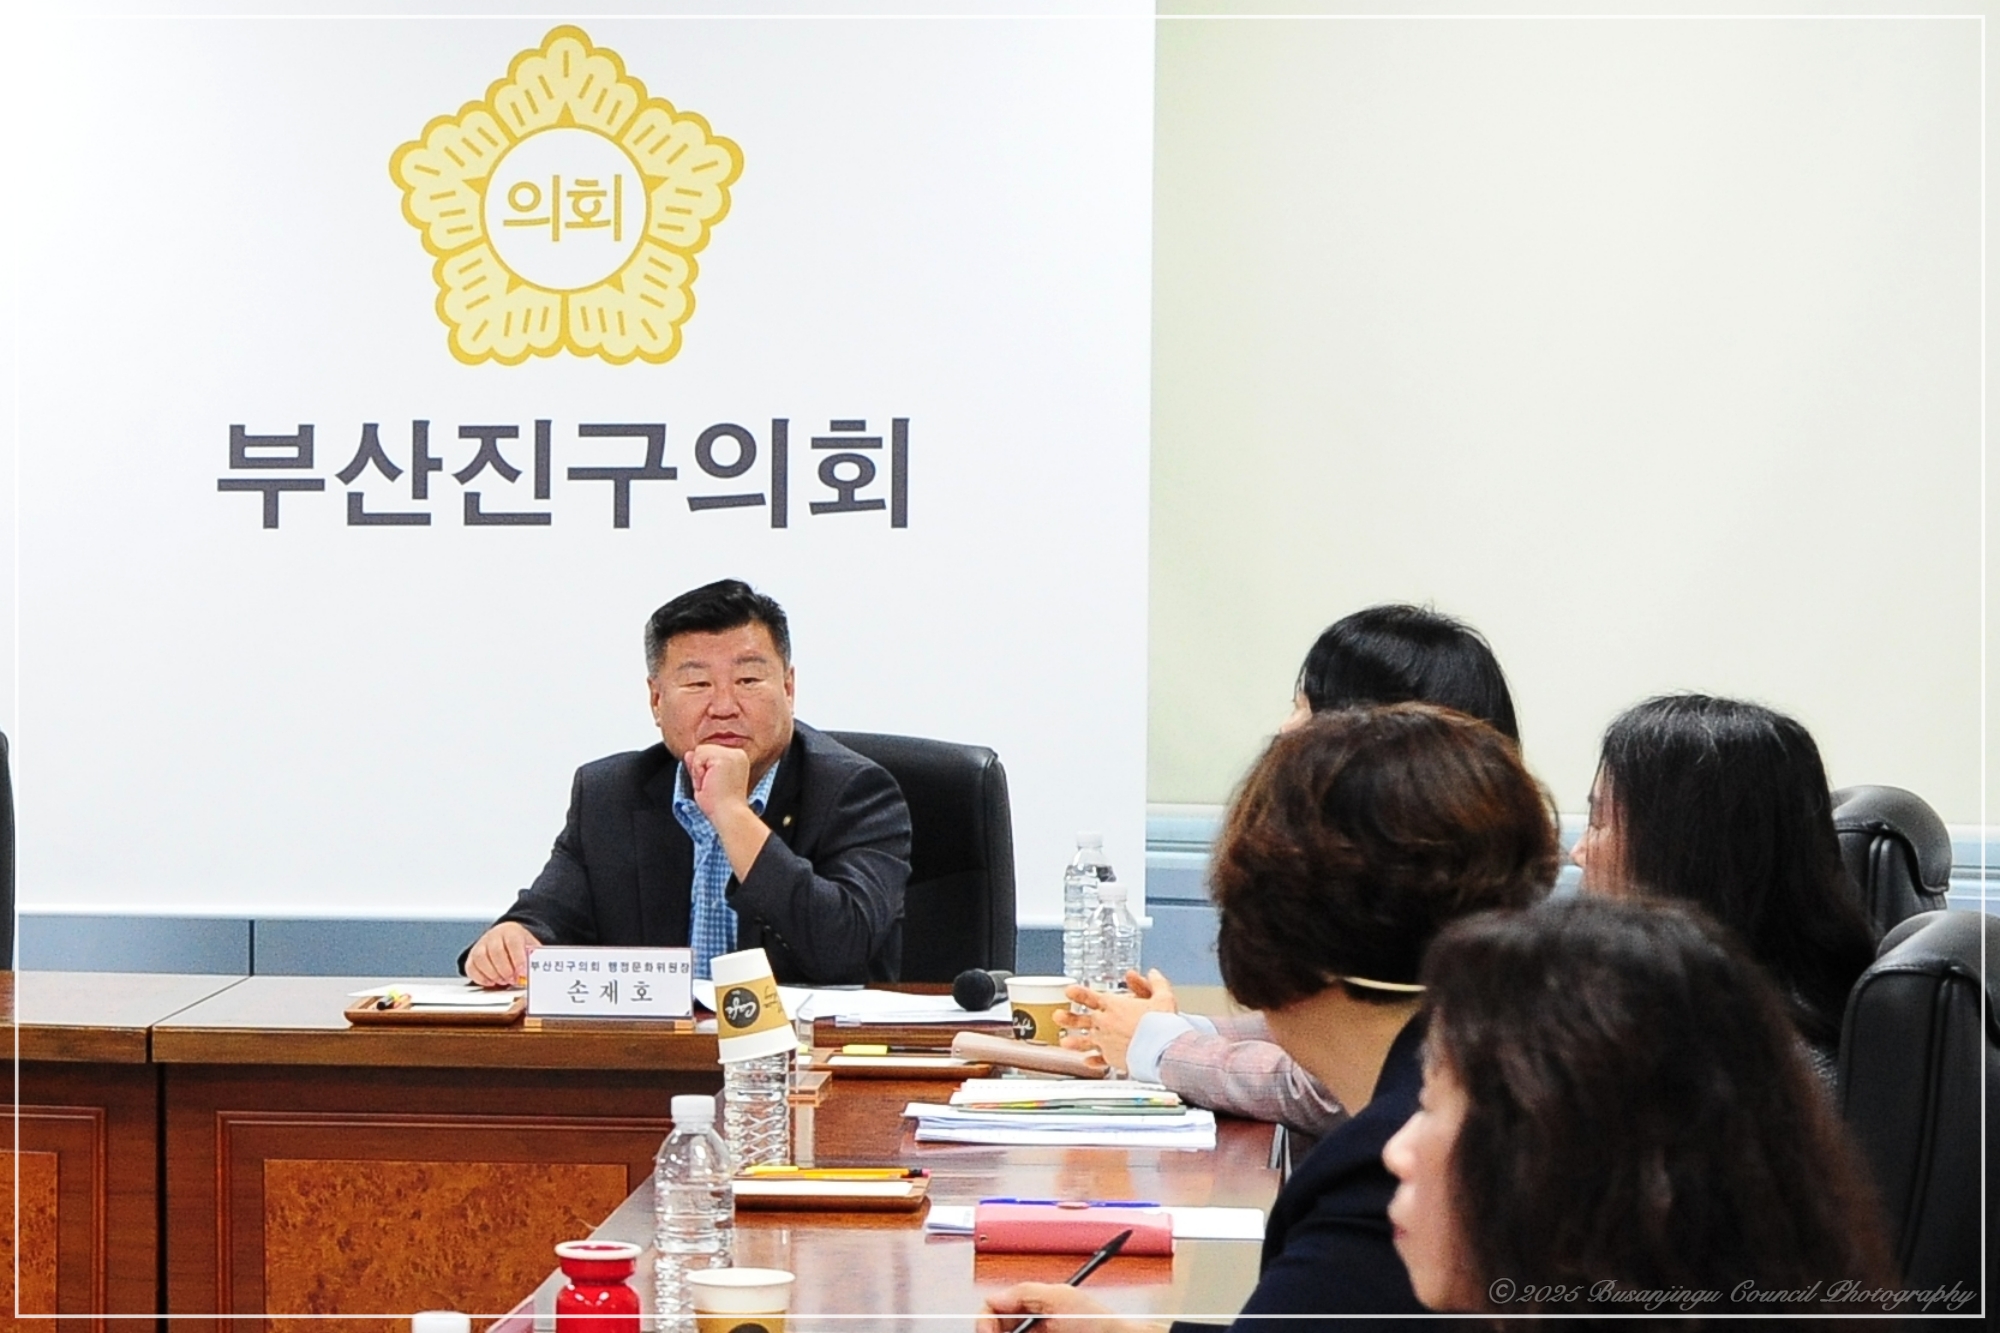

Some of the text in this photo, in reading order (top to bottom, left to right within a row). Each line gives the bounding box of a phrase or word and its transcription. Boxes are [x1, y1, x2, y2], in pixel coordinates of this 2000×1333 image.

[503, 174, 622, 242] 의회
[217, 418, 910, 529] 부산진구의회
[531, 960, 690, 973] 부산진구의회 행정문화위원장
